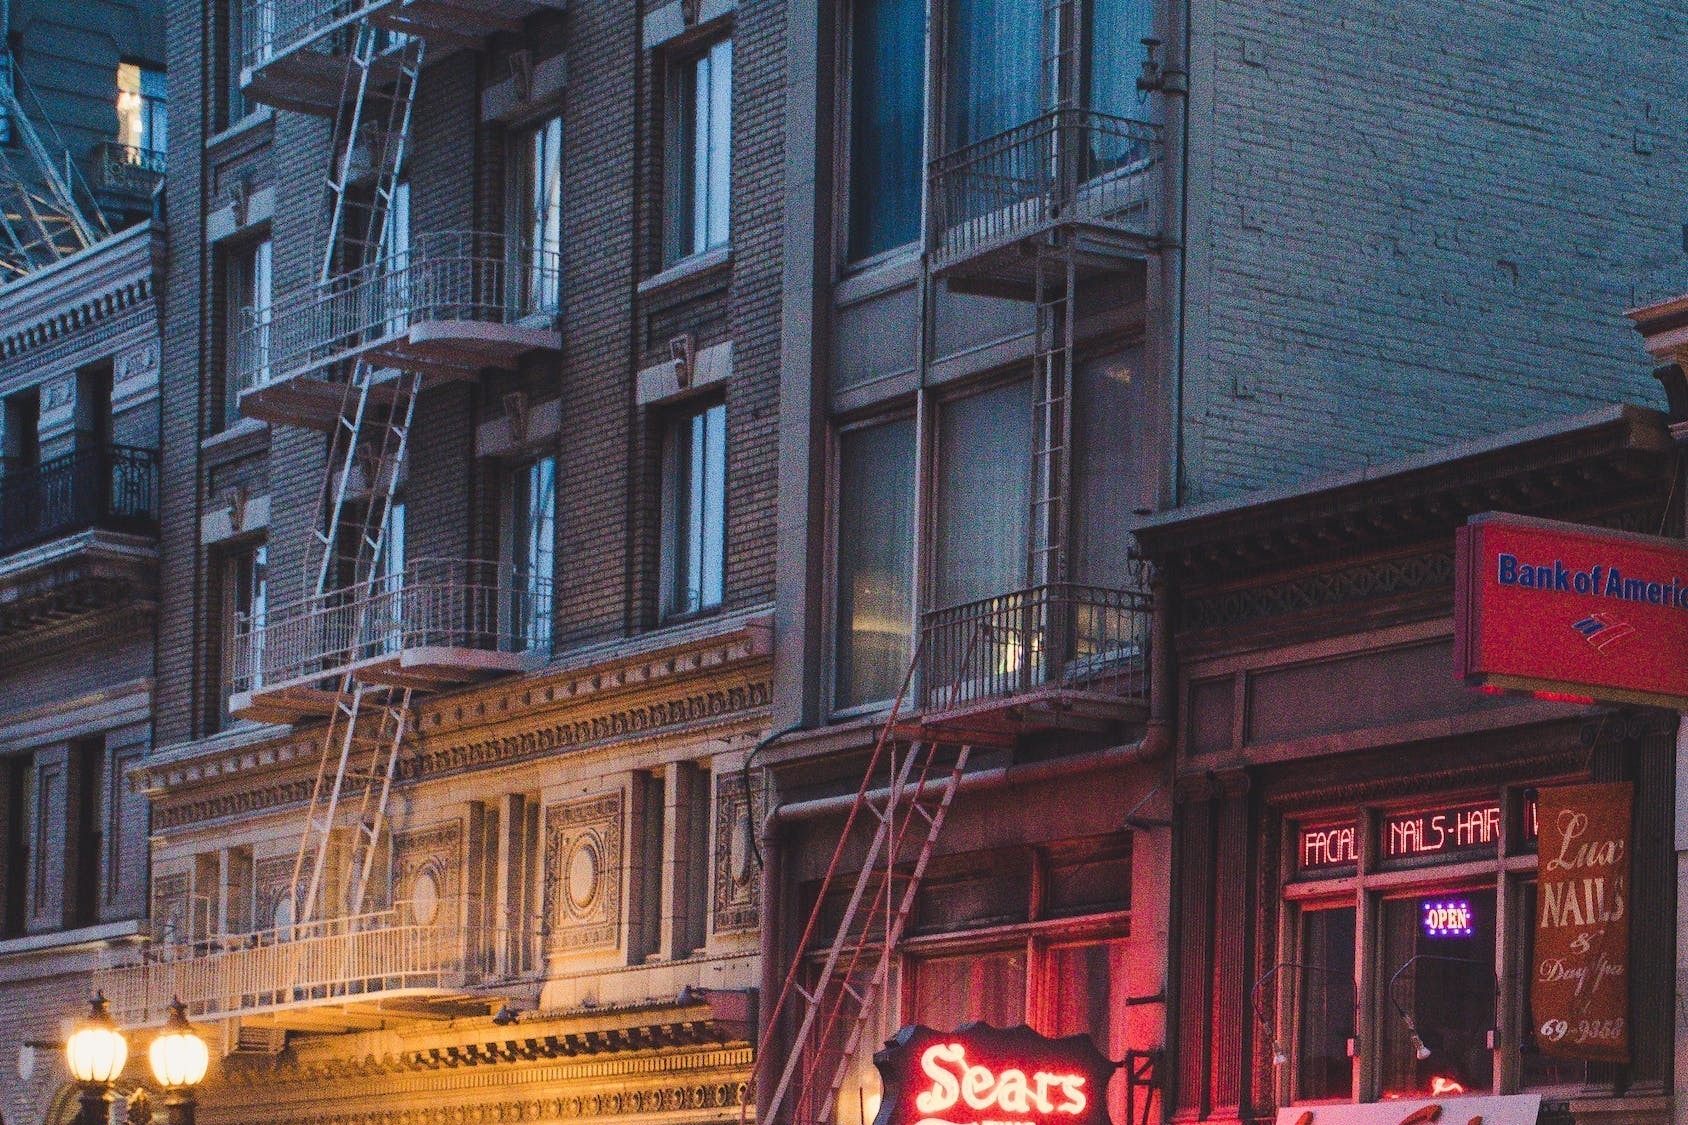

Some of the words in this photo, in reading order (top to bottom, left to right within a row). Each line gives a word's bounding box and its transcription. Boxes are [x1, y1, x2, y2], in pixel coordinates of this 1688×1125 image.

[1497, 552, 1570, 592] Bank
[1573, 564, 1603, 595] of
[1305, 827, 1358, 866] FACIAL
[1546, 809, 1624, 872] Lux
[1428, 908, 1467, 930] OPEN
[915, 1043, 1087, 1115] Sears
